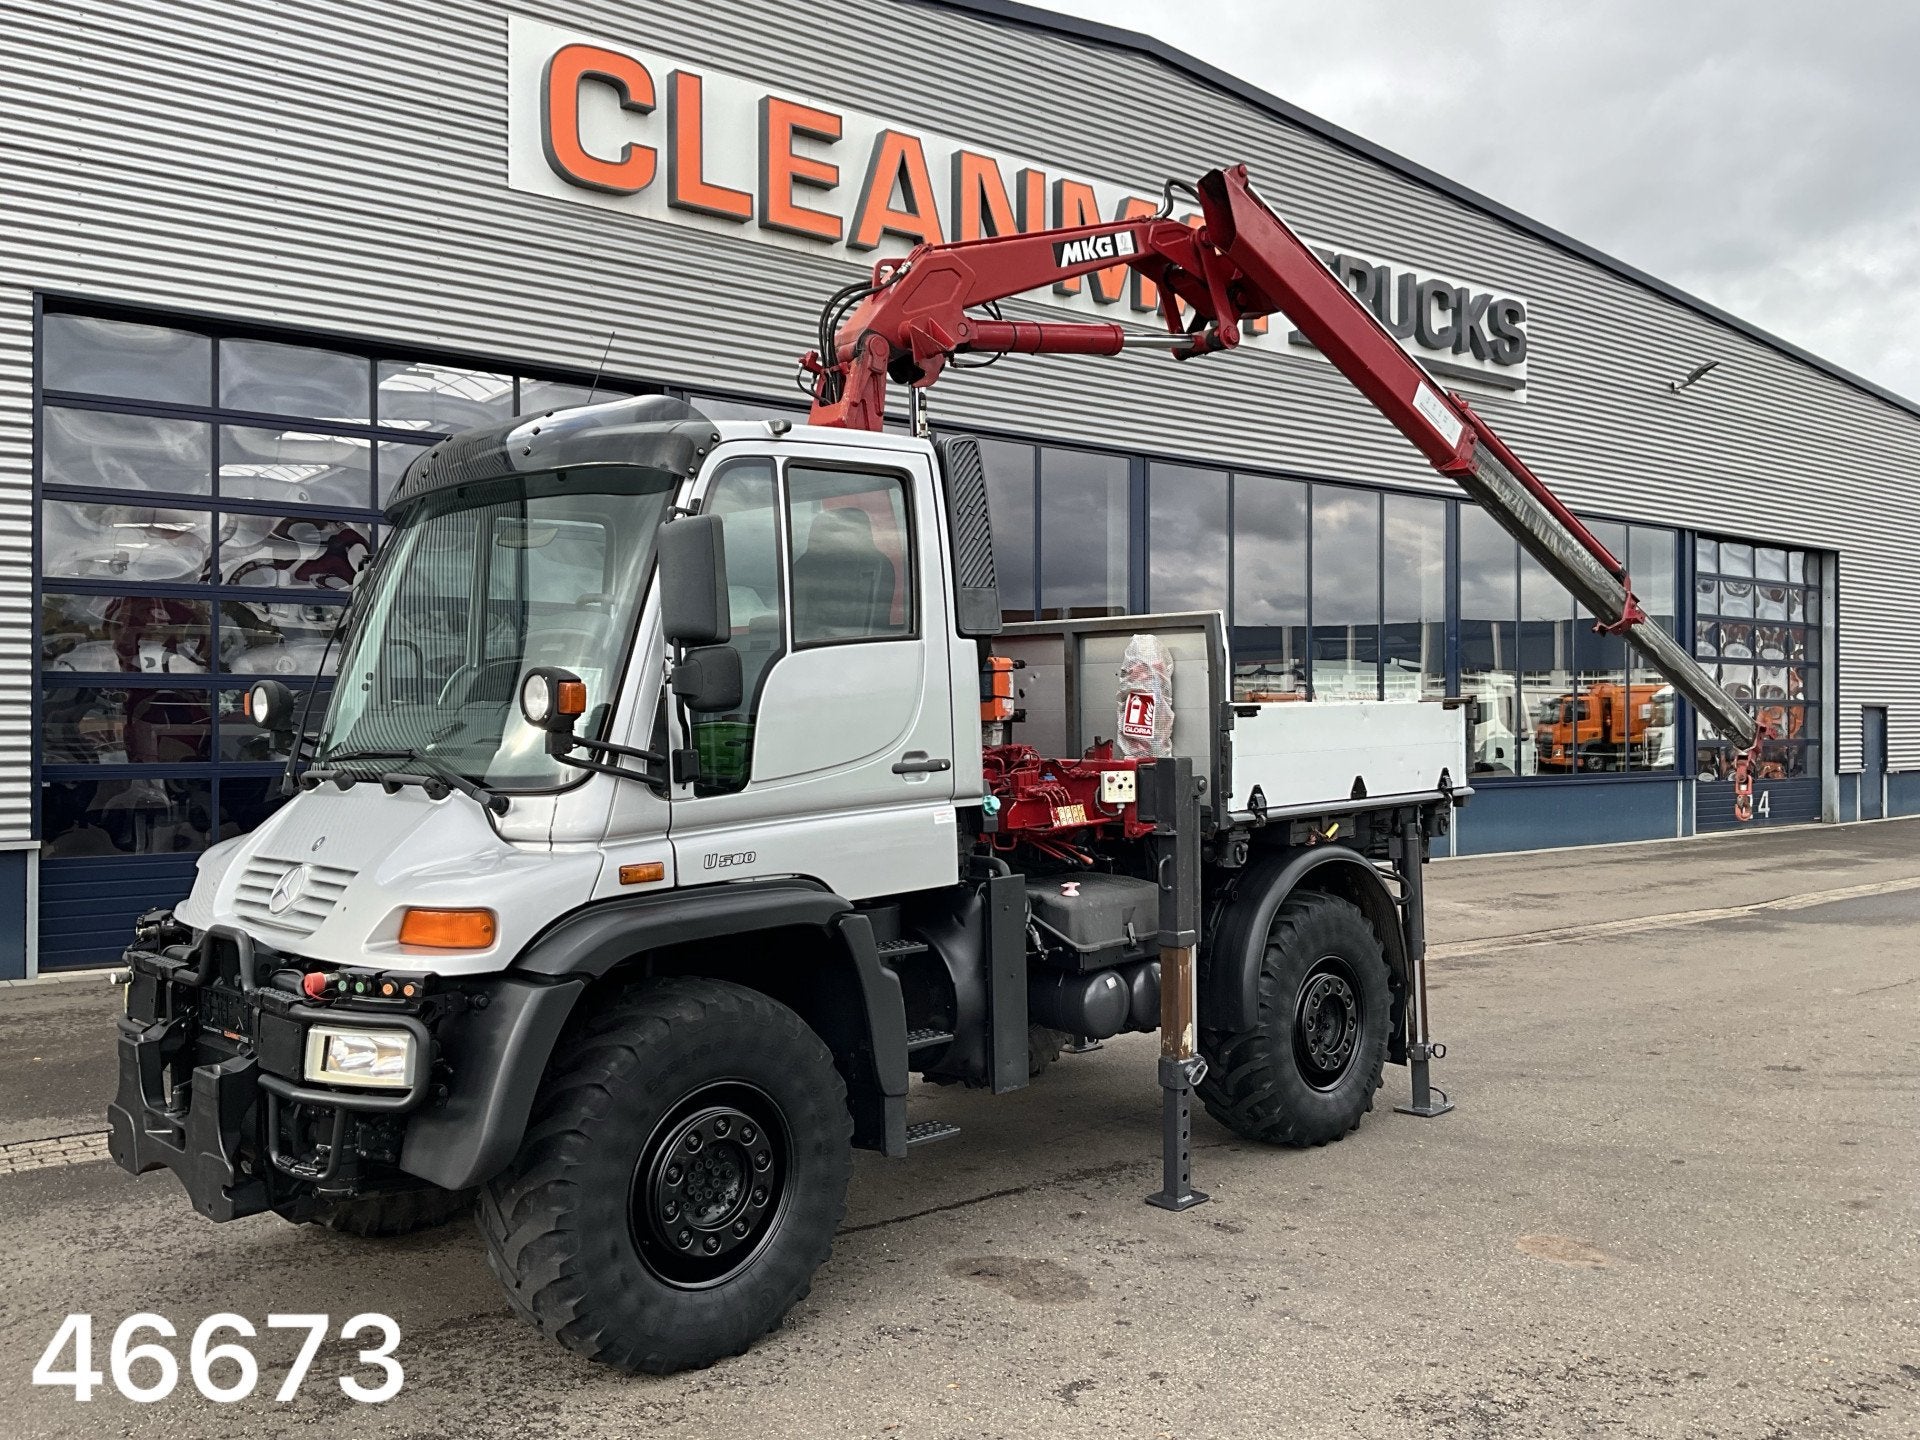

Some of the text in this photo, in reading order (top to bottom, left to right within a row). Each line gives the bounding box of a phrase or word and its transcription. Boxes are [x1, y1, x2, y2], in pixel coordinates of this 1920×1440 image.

[541, 42, 1528, 366] CLEANM RUCKS
[1060, 235, 1114, 268] MKG
[1125, 726, 1152, 735] GLORIA
[703, 851, 757, 869] U 500
